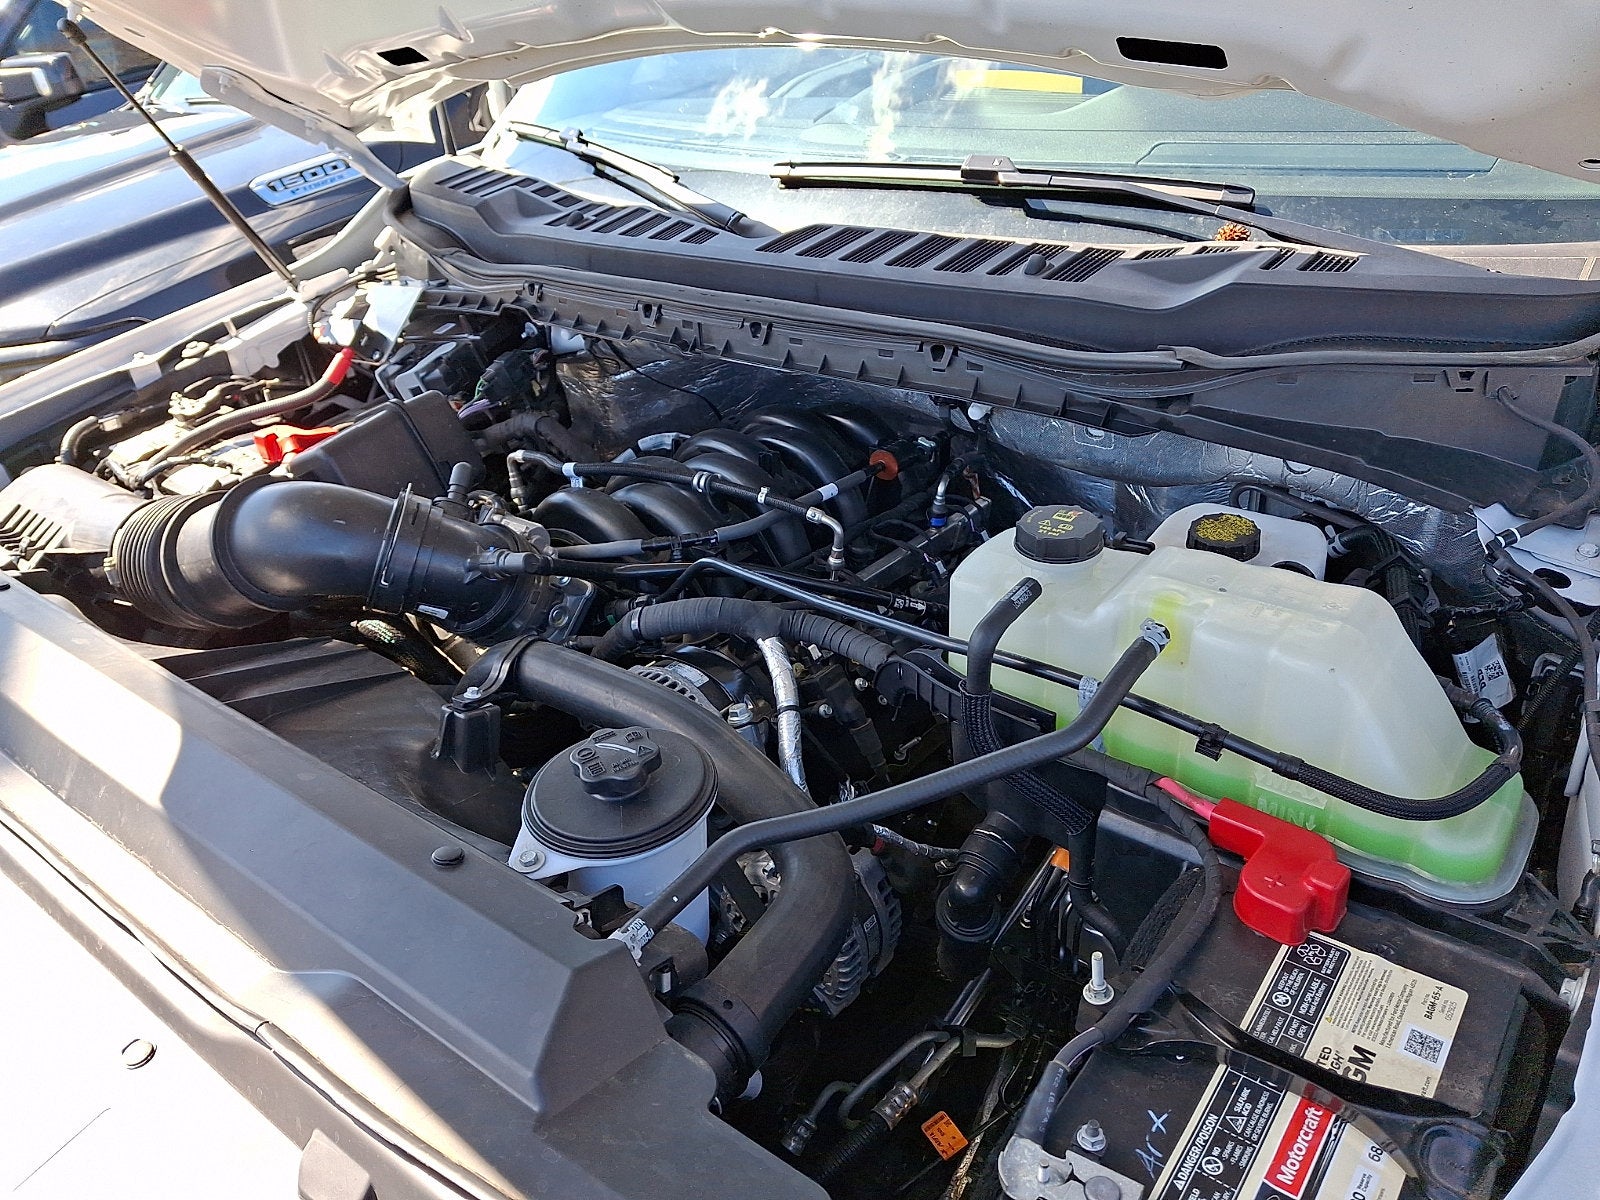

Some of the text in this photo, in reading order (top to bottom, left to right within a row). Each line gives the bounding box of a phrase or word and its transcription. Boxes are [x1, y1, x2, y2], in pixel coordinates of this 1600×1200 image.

[267, 159, 350, 191] 1500
[1298, 977, 1320, 1015] NON-SPILLABLE
[1178, 1113, 1219, 1181] DANGER/POISON
[1211, 1145, 1221, 1157] NO
[1277, 1107, 1323, 1186] Motorcraft
[1368, 1146, 1383, 1162] 68
